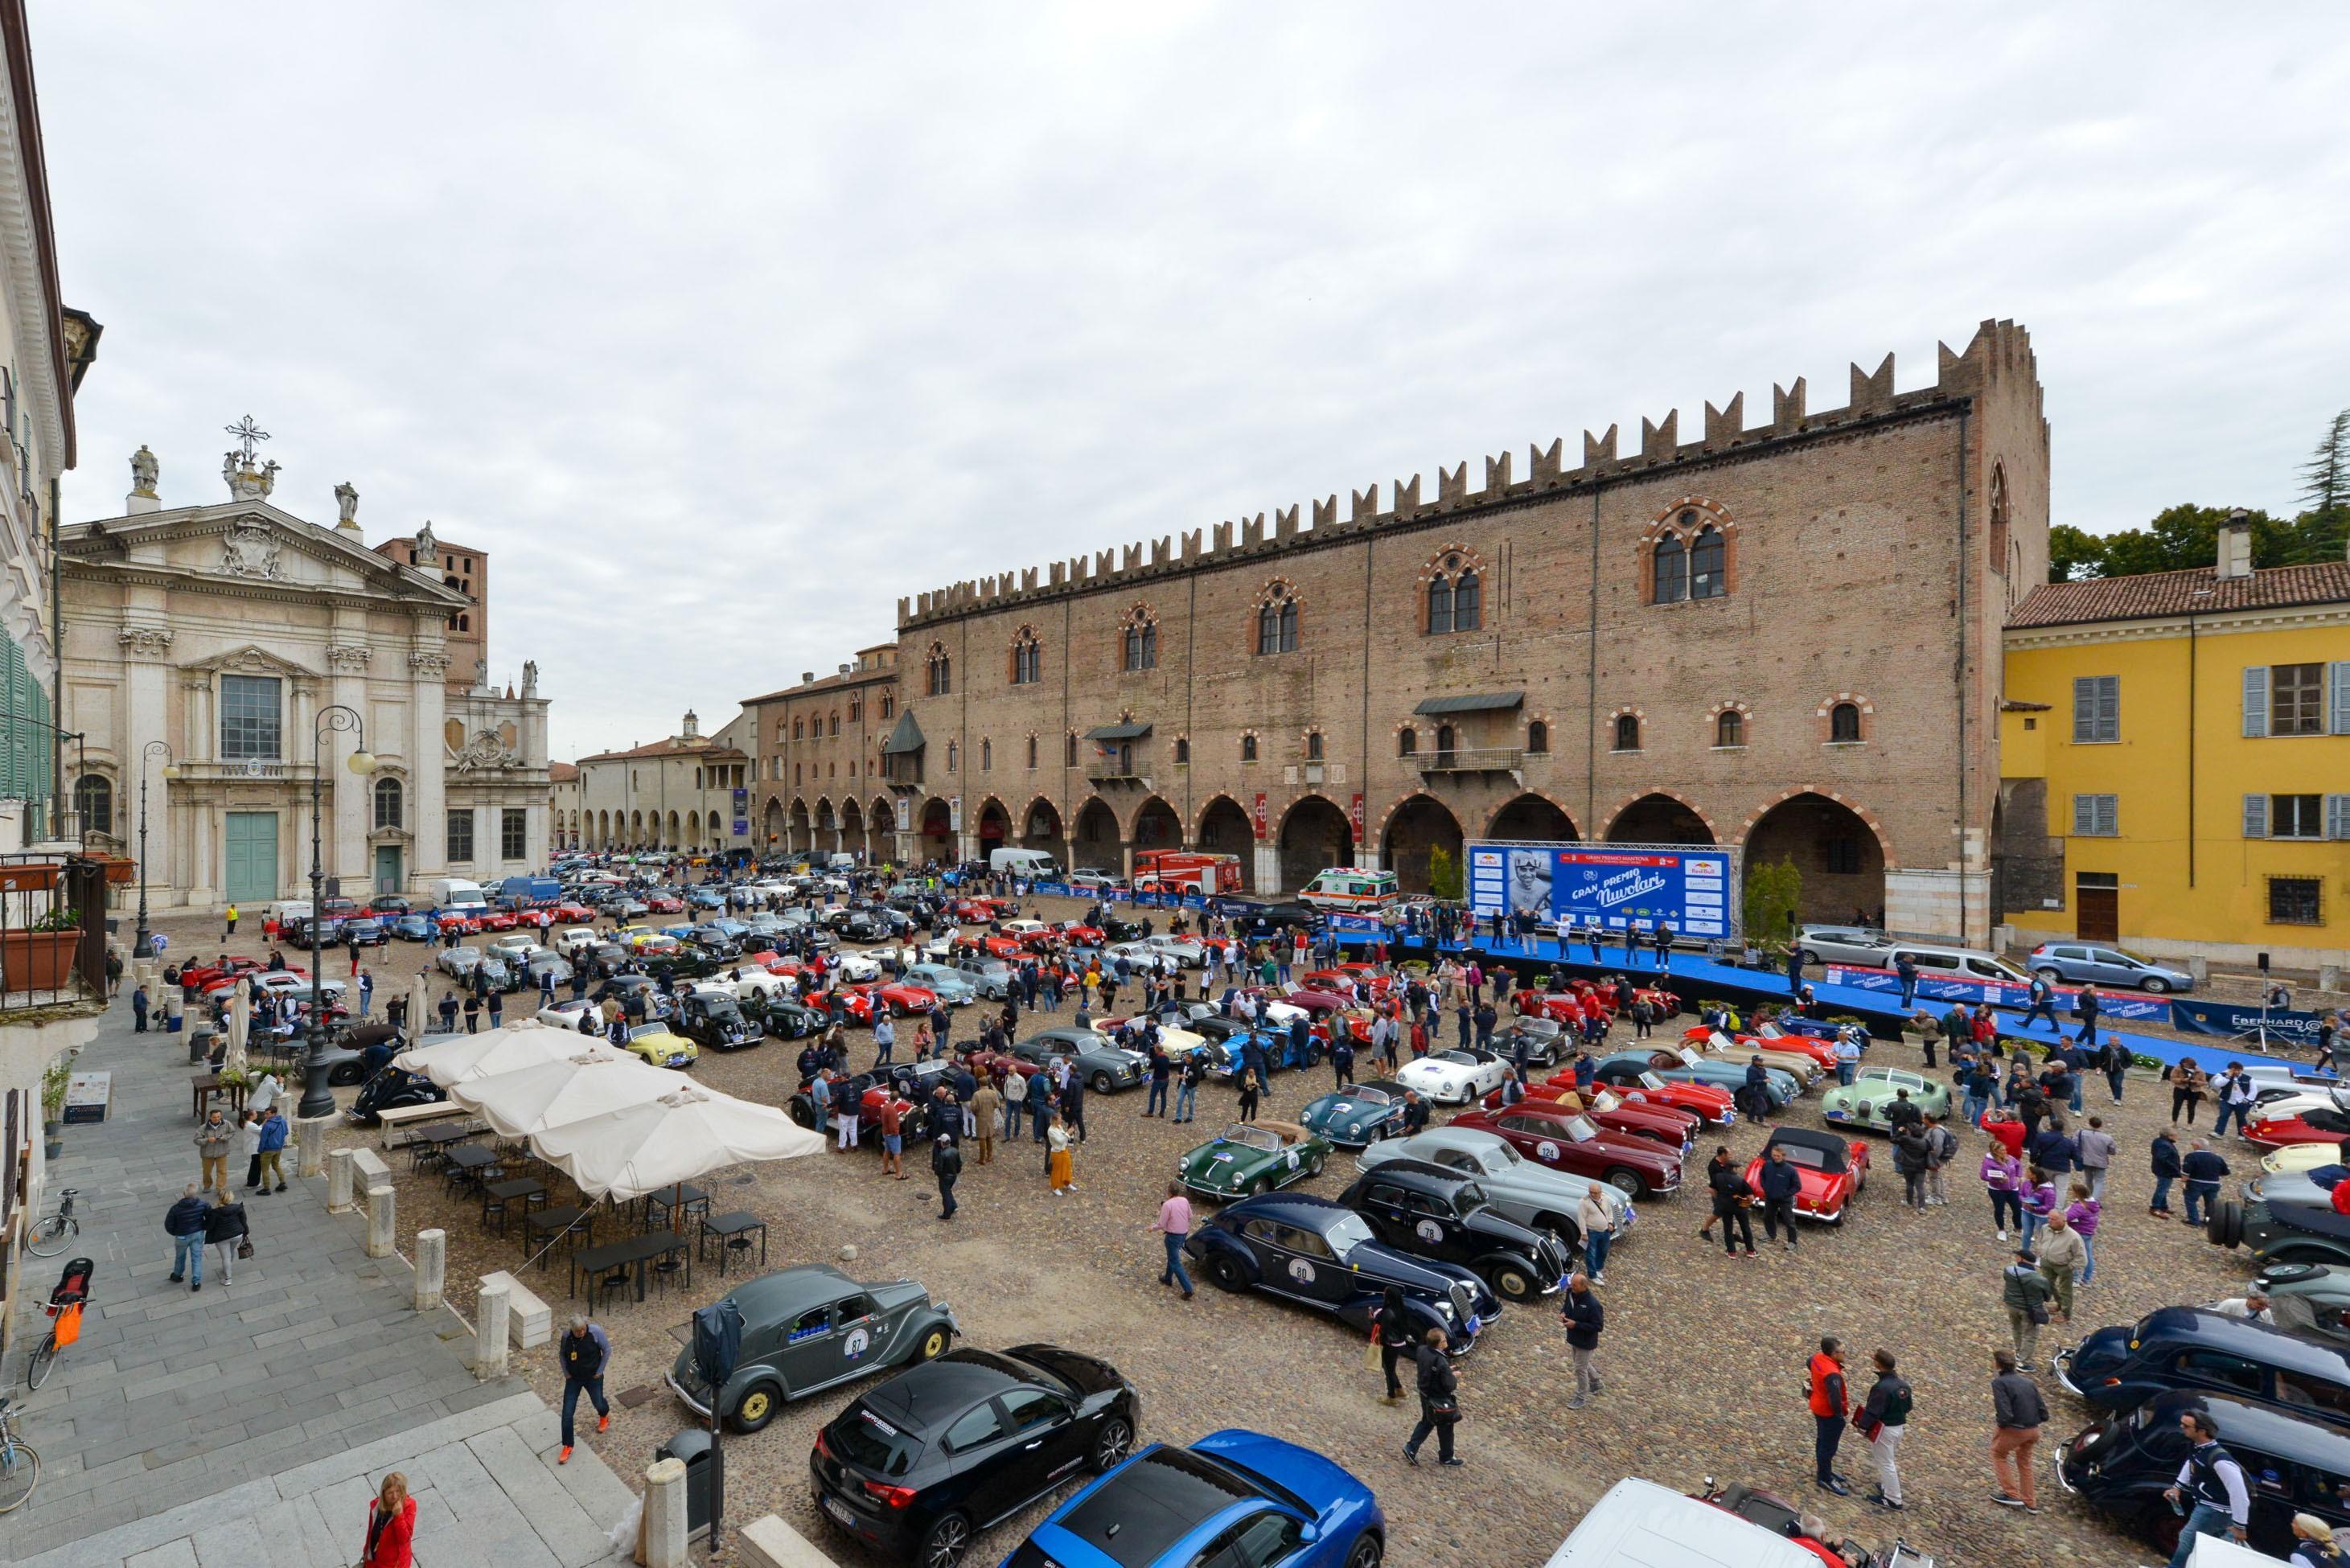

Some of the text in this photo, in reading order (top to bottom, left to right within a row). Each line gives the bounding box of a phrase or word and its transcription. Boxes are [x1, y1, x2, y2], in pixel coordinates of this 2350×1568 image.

[1571, 868, 1640, 900] GRAN PREMIO
[1596, 871, 1666, 907] Nuvolari
[2232, 1014, 2304, 1026] EBERHARD
[1543, 1147, 1554, 1157] 124
[1424, 1227, 1434, 1238] 78
[1296, 1266, 1307, 1279] 80
[852, 1339, 861, 1352] 87
[861, 1410, 878, 1422] GRUPPO
[877, 1418, 898, 1435] BOSSONI
